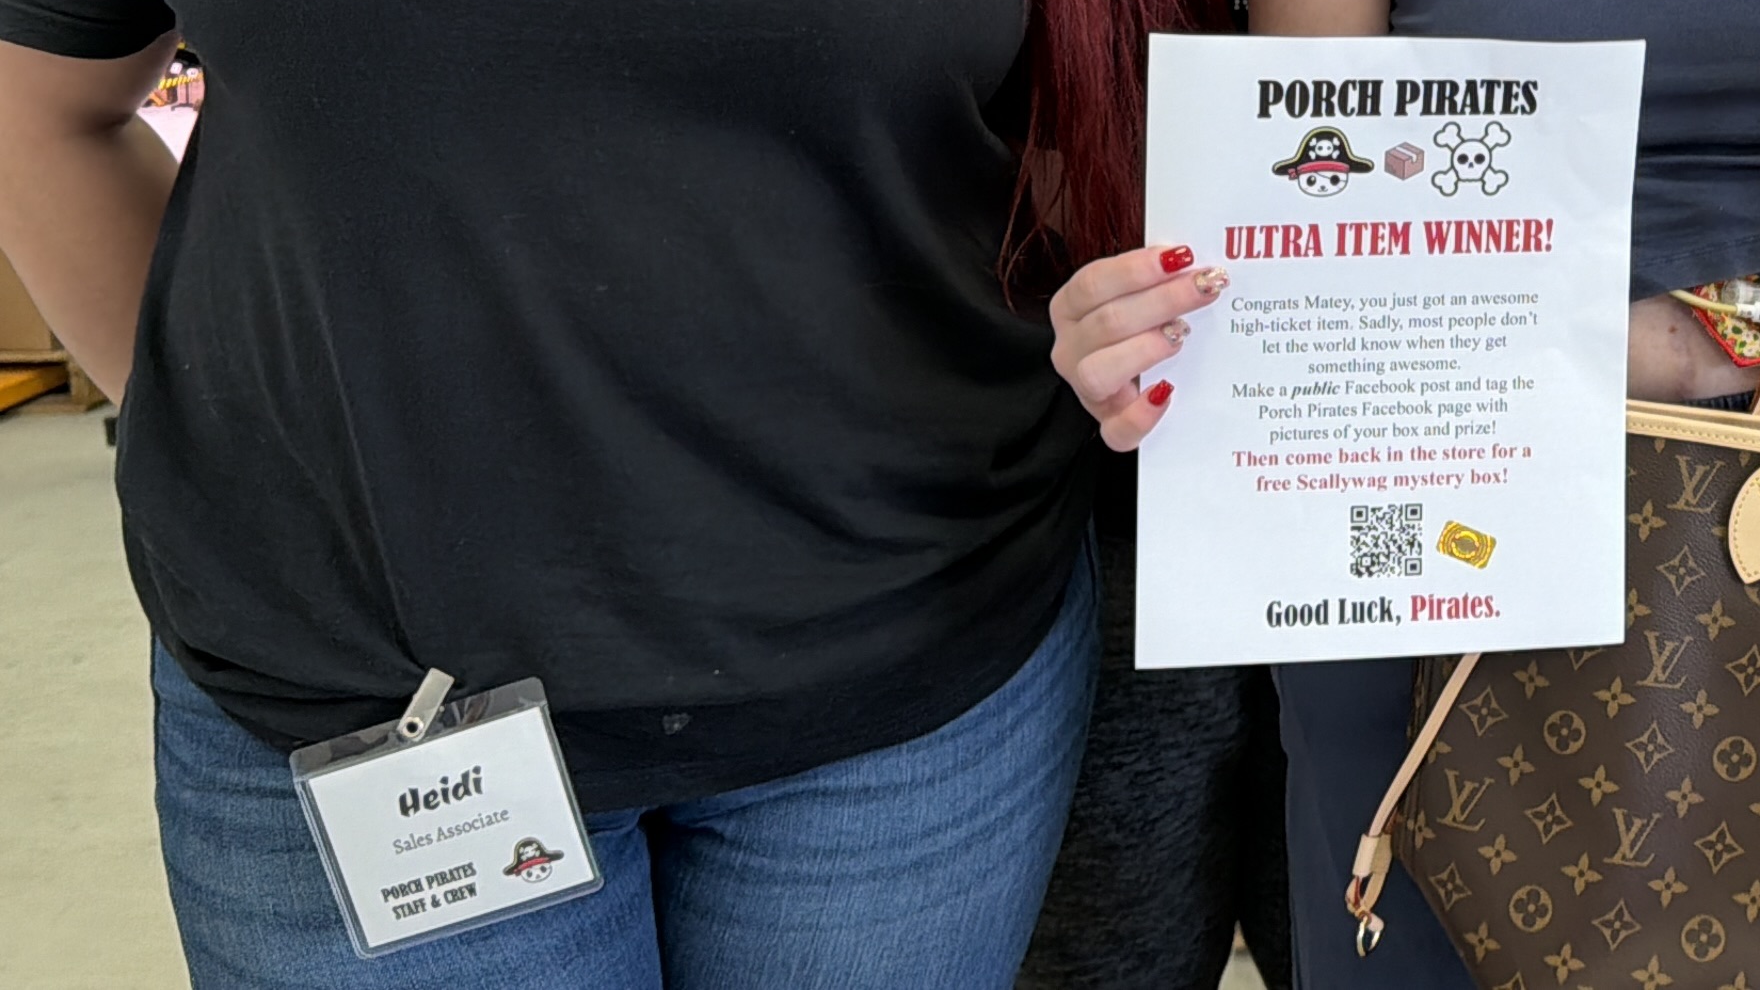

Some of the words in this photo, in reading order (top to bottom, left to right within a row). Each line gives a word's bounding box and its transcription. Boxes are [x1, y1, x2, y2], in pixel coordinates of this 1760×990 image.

[1257, 79, 1384, 118] PORCH
[1394, 78, 1539, 116] PIRATES
[1224, 222, 1322, 260] ULTRA
[1334, 221, 1412, 257] ITEM
[1423, 218, 1554, 254] WINNER!
[1232, 297, 1299, 314] Congrats
[1304, 295, 1355, 312] Matey,
[1359, 297, 1387, 311] you
[1390, 292, 1418, 310] just
[1422, 294, 1445, 310] got
[1450, 294, 1467, 306] an
[1471, 293, 1539, 305] awesome
[1230, 318, 1311, 336] high-ticket
[1317, 316, 1353, 331] item.
[1359, 314, 1403, 332] Sadly,
[1408, 315, 1443, 328] most
[1448, 312, 1496, 331] people
[1500, 311, 1538, 326] don't
[1262, 339, 1280, 353] let
[1286, 339, 1309, 353] the
[1313, 337, 1356, 352] world
[1361, 336, 1401, 351] know
[1406, 335, 1445, 350] when
[1450, 334, 1481, 352] they
[1485, 335, 1507, 351] get
[1308, 358, 1385, 376] something
[1389, 359, 1461, 371] awesome.
[1232, 382, 1275, 398] Make
[1279, 385, 1287, 397] a
[1290, 381, 1341, 400] public
[1345, 378, 1415, 394] Facebook
[1420, 380, 1450, 396] post
[1455, 376, 1481, 391] and
[1486, 377, 1508, 394] tag
[1512, 375, 1535, 390] the
[1258, 403, 1302, 419] Porch
[1307, 402, 1357, 418] Pirates
[1362, 399, 1433, 417] Facebook
[1437, 401, 1472, 418] page
[1476, 397, 1508, 413] with
[1269, 426, 1329, 445] pictures
[1333, 424, 1351, 439] of
[1353, 425, 1388, 442] your
[1392, 422, 1419, 437] box
[1423, 421, 1450, 436] and
[1455, 420, 1496, 439] prize!
[1232, 450, 1279, 467] Then
[1285, 450, 1333, 465] come
[1338, 446, 1381, 464] back
[1387, 445, 1403, 461] in
[1410, 445, 1437, 461] the
[1442, 444, 1486, 460] store
[1491, 443, 1517, 458] for
[1522, 445, 1532, 458] a
[1256, 475, 1292, 492] free
[1296, 473, 1387, 493] Scallywag
[1393, 471, 1465, 491] mystery
[1470, 467, 1508, 485] box!
[1266, 598, 1329, 628] Good
[1337, 595, 1401, 627] Luck,
[1410, 593, 1501, 622] Pirates.
[398, 765, 484, 817] Heidi
[393, 829, 434, 855] Sales
[436, 809, 510, 842] Associate
[380, 874, 424, 903] PORCH
[425, 862, 477, 890] PIRATES
[392, 898, 427, 920] STAFF
[431, 893, 441, 908] &
[444, 882, 478, 905] CREW
